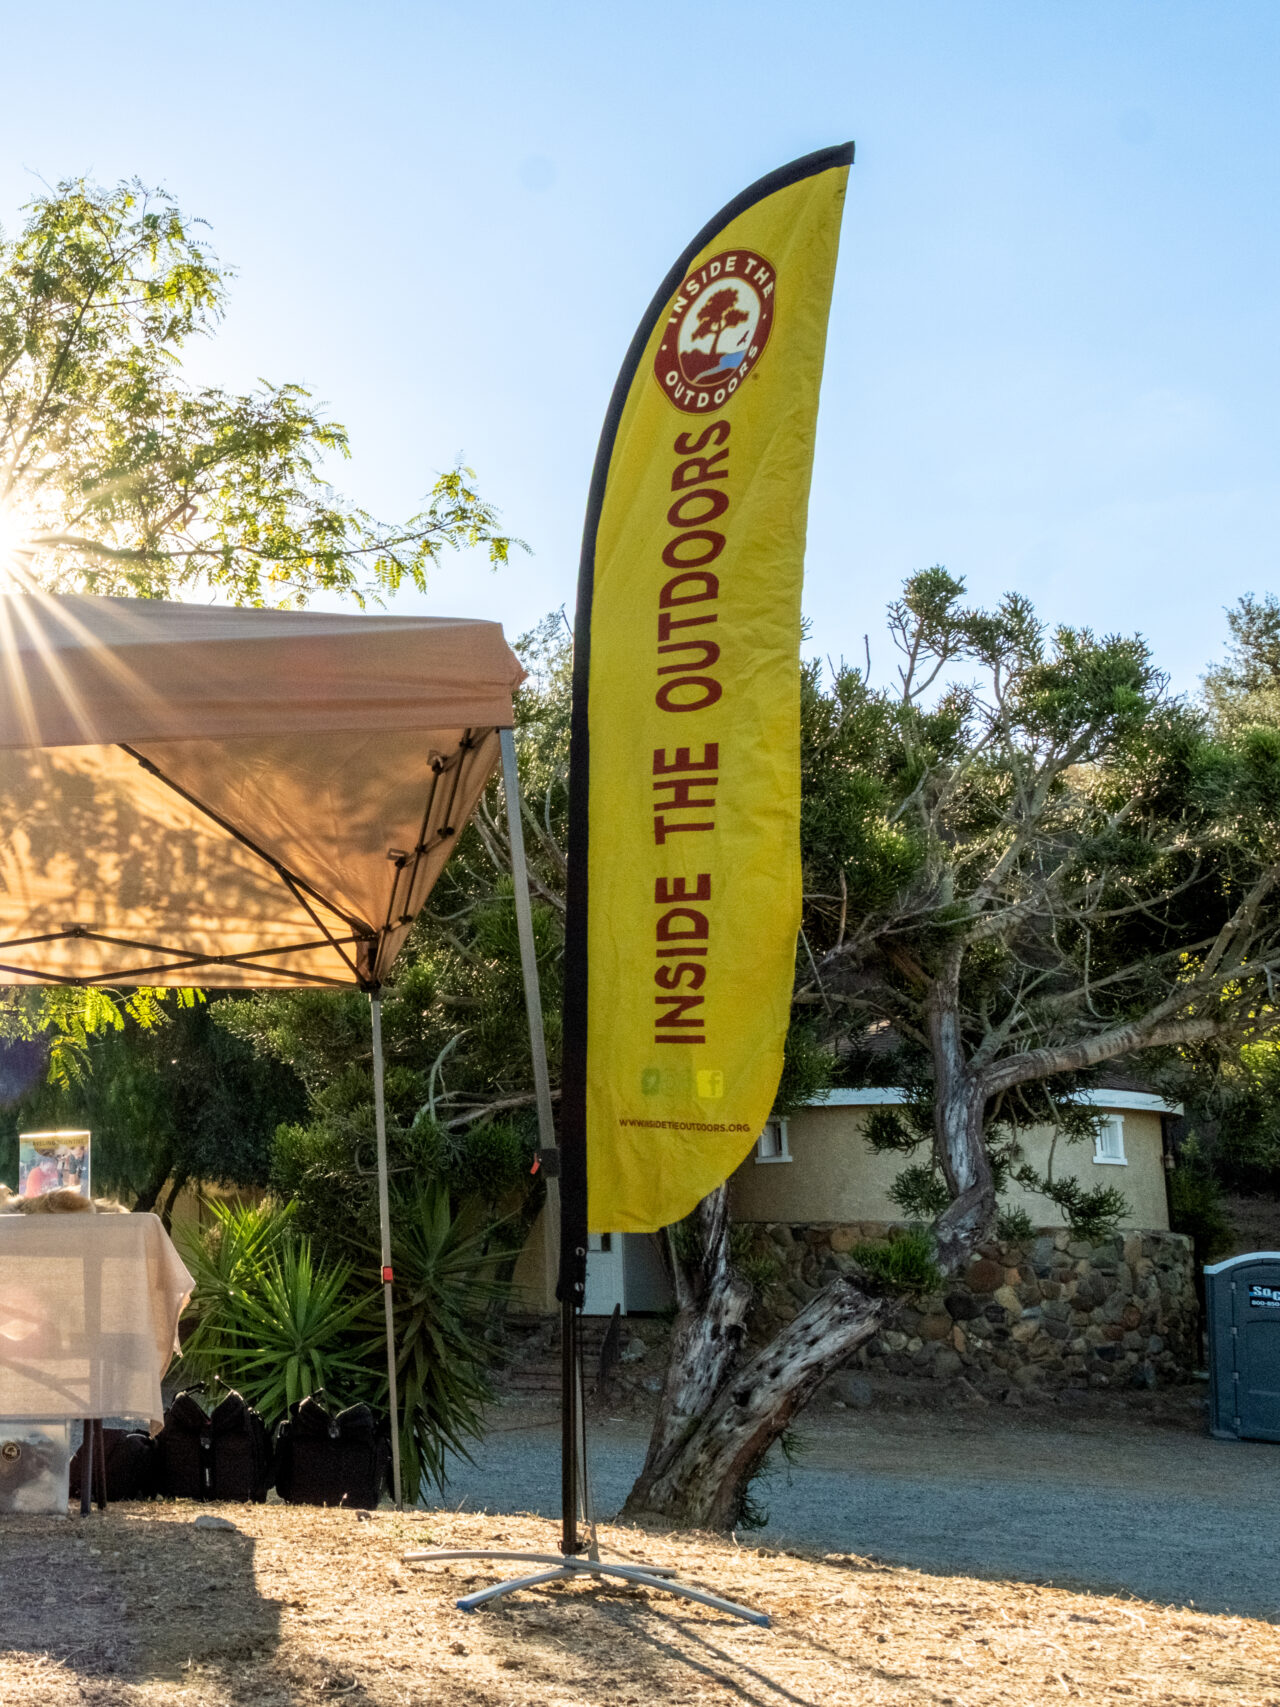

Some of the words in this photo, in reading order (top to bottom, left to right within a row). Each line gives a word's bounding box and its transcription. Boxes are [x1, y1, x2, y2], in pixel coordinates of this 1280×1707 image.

[668, 256, 738, 324] INSIDE
[744, 258, 775, 299] THE
[665, 345, 759, 408] OUTDOORS
[655, 419, 731, 713] OUTDOORS
[652, 742, 719, 845] THE
[654, 873, 711, 1044] INSIDE
